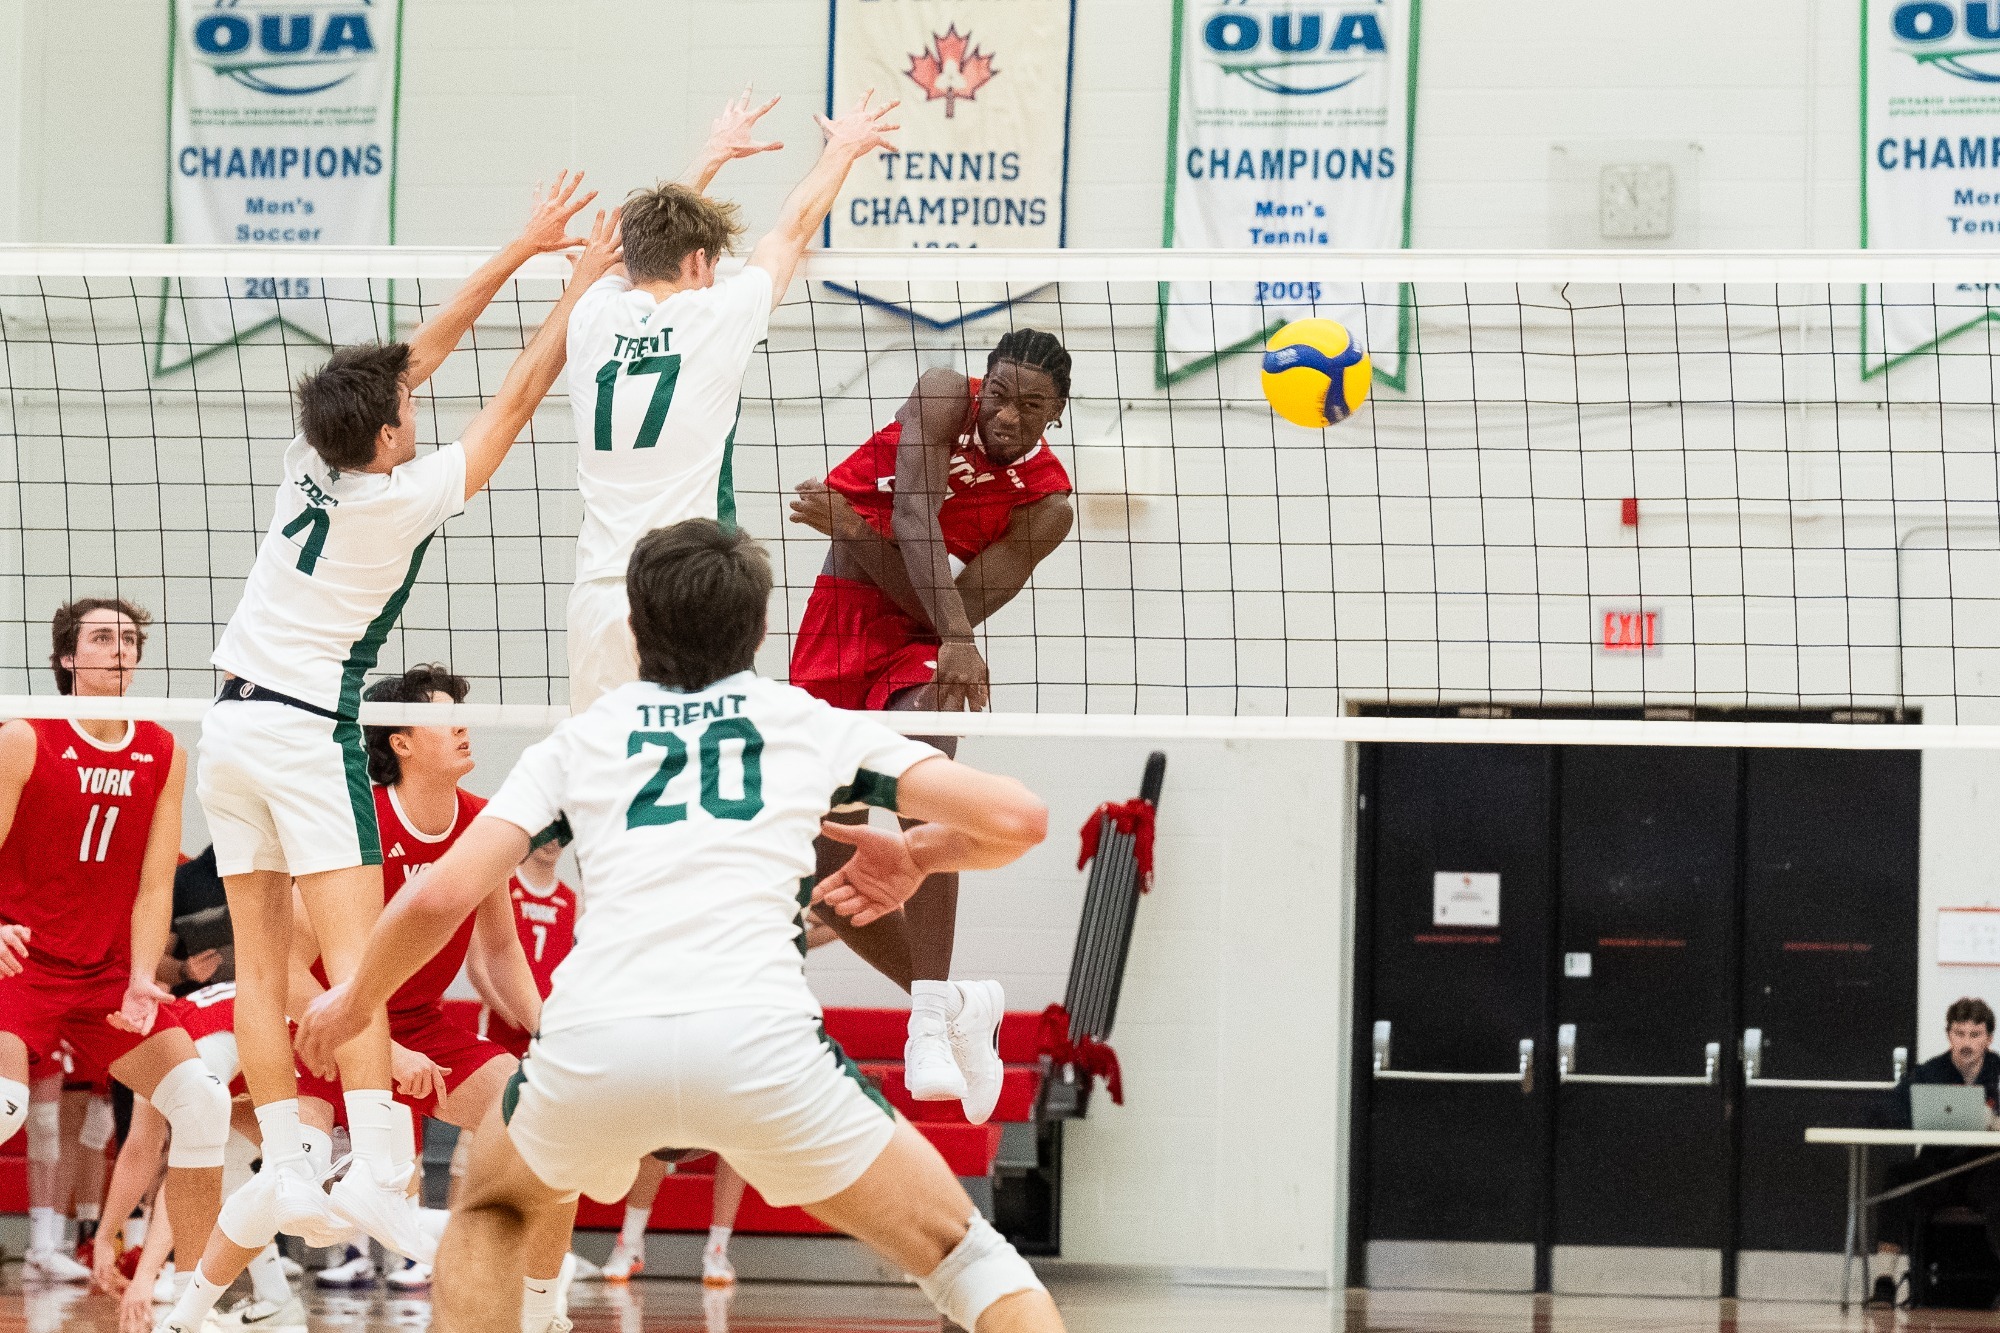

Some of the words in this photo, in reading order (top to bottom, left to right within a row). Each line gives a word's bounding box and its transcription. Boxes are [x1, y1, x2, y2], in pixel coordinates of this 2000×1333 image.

[195, 14, 376, 55] OUA
[1205, 14, 1386, 53] OUA
[179, 144, 383, 178] CHAMPIONS
[879, 151, 1020, 181] TENNIS
[1187, 148, 1395, 180] CHAMPIONS
[246, 197, 315, 215] Men's
[850, 197, 1046, 227] CHAMPIONS
[1255, 201, 1326, 217] Men's
[236, 224, 322, 242] Soccer
[1249, 228, 1328, 245] Tennis
[1948, 216, 2000, 233] Ten
[246, 278, 310, 299] 2015
[1255, 282, 1321, 300] 2005
[614, 327, 673, 359] TRENT
[594, 353, 681, 451] 17
[1604, 612, 1656, 649] EXIT
[637, 694, 746, 727] TRENT
[77, 766, 135, 796] YORK
[626, 717, 764, 831] 20
[79, 804, 119, 862] 11
